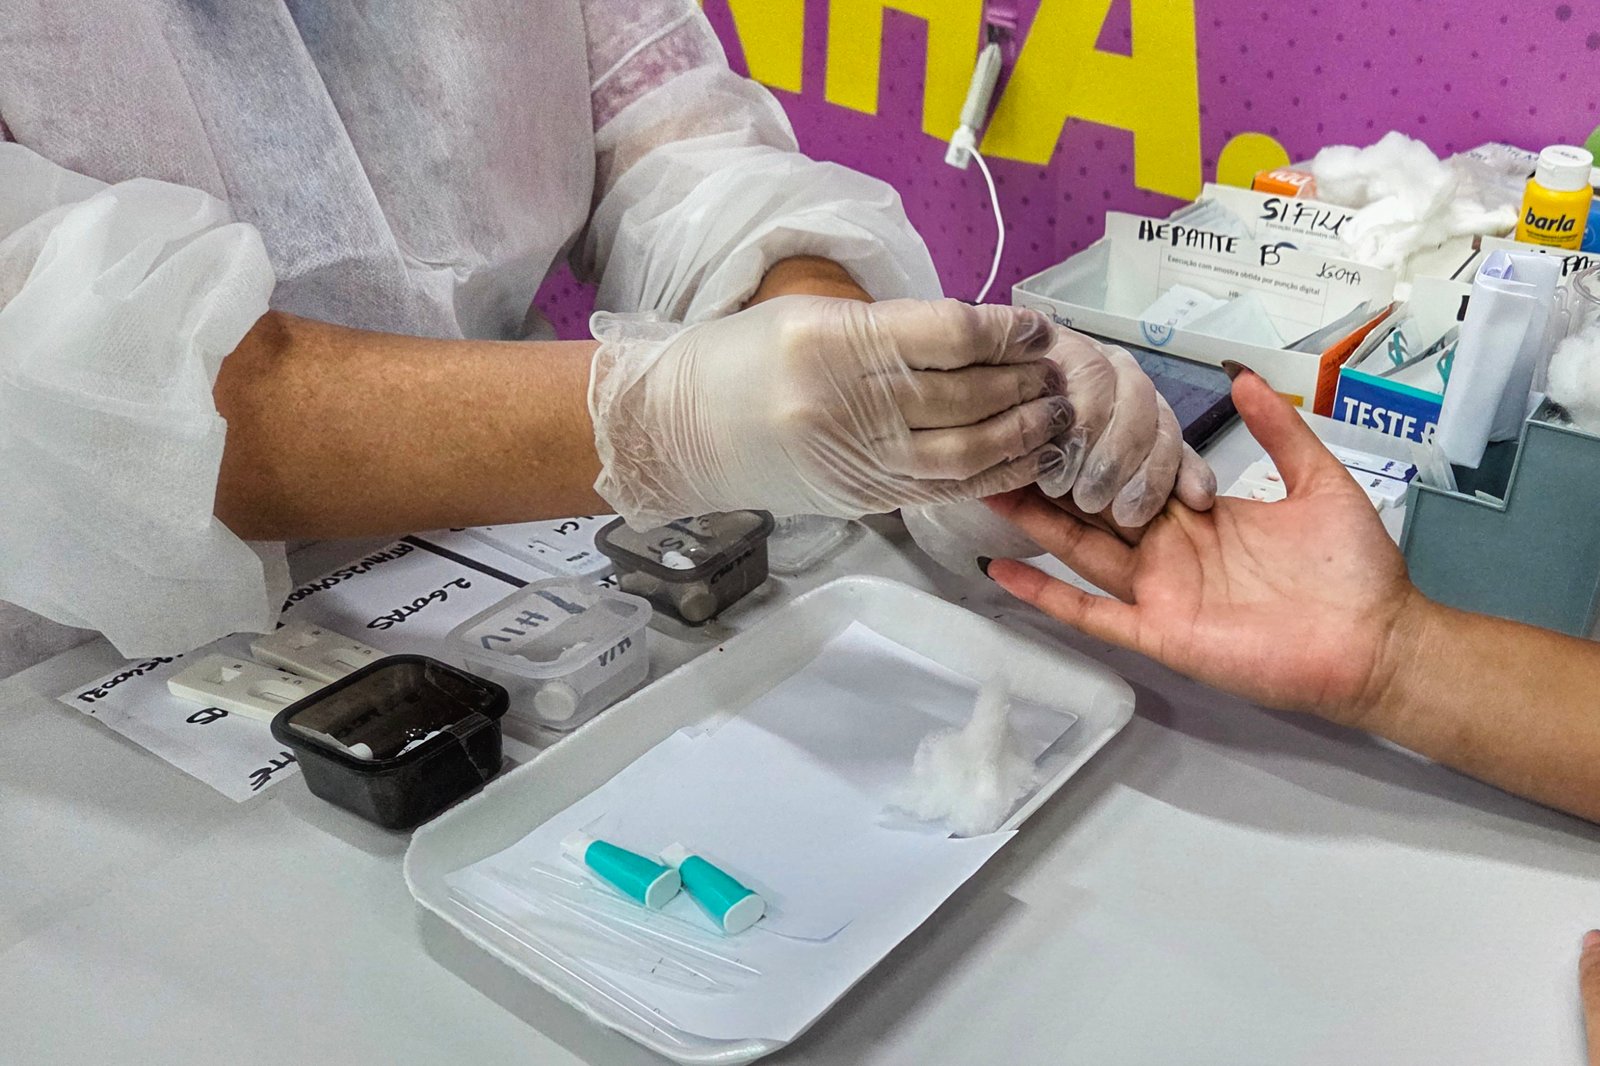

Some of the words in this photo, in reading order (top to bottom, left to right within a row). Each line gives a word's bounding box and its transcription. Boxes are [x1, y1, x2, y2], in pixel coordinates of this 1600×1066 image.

[1138, 220, 1240, 254] HEPATITE
[1525, 207, 1576, 232] barla
[1167, 254, 1197, 269] Execução
[1198, 260, 1212, 270] com
[1213, 265, 1239, 277] amostra
[1240, 269, 1261, 282] obtida
[1262, 275, 1274, 285] por
[1274, 279, 1298, 292] punção
[1299, 282, 1321, 296] digital
[1343, 396, 1417, 441] TESTE
